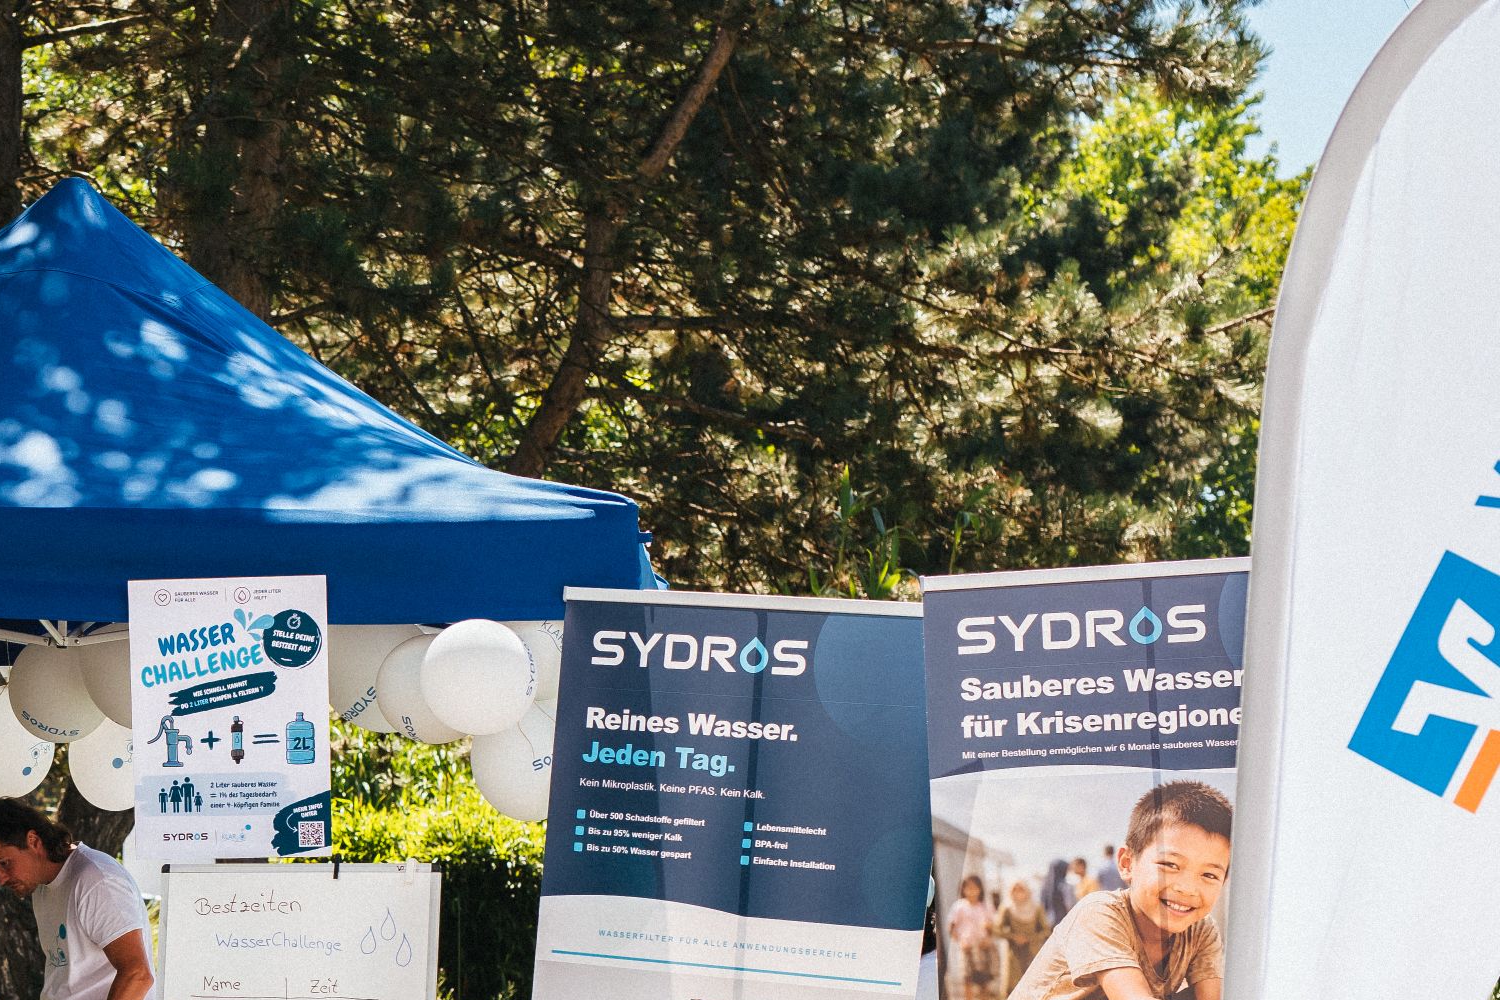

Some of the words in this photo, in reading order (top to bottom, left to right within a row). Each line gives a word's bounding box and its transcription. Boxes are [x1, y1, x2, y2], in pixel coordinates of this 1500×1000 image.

[157, 622, 236, 657] WASSER
[956, 603, 1207, 656] SYDROS
[590, 629, 809, 677] SYDROS
[140, 643, 264, 689] CHALLENGE
[960, 674, 1115, 702] Sauberes
[585, 706, 680, 734] Reines
[687, 712, 798, 742] Wasser.
[960, 714, 1009, 739] für
[1016, 703, 1242, 736] Krisenregione
[293, 736, 311, 751] 2L
[961, 750, 976, 760] Mit
[976, 750, 1000, 759] einer
[1000, 747, 1048, 758] Bestellung
[1048, 744, 1103, 756] ermöglichen
[1103, 743, 1118, 753] wir
[1118, 743, 1126, 752] 6
[1127, 742, 1161, 751] Monate
[1162, 740, 1204, 750] sauberes
[581, 740, 666, 768] Jeden
[674, 746, 736, 777] Tag.
[578, 776, 600, 788] Kein
[601, 778, 657, 792] Mikroplastik.
[659, 782, 687, 794] Keine
[687, 784, 718, 796] PFAS.
[719, 787, 742, 798] Kein
[742, 788, 766, 800] Kalk.
[588, 808, 609, 820] Über
[609, 811, 625, 821] 500
[624, 812, 673, 825] Schadstoffe
[672, 817, 706, 827] gefiltert
[162, 832, 209, 842] SYDROS
[587, 826, 602, 836] Bis
[601, 828, 613, 837] zu
[612, 828, 631, 838] 95%
[630, 831, 664, 842] weniger
[663, 832, 683, 842] Kalk
[755, 822, 827, 836] Lebensmittelecht
[754, 839, 789, 850] BPA-frei
[752, 855, 789, 867] Einfache
[789, 858, 836, 871] Installation
[193, 889, 302, 916] Bestzeiten
[202, 975, 241, 992] Name
[309, 977, 338, 994] Zeit
